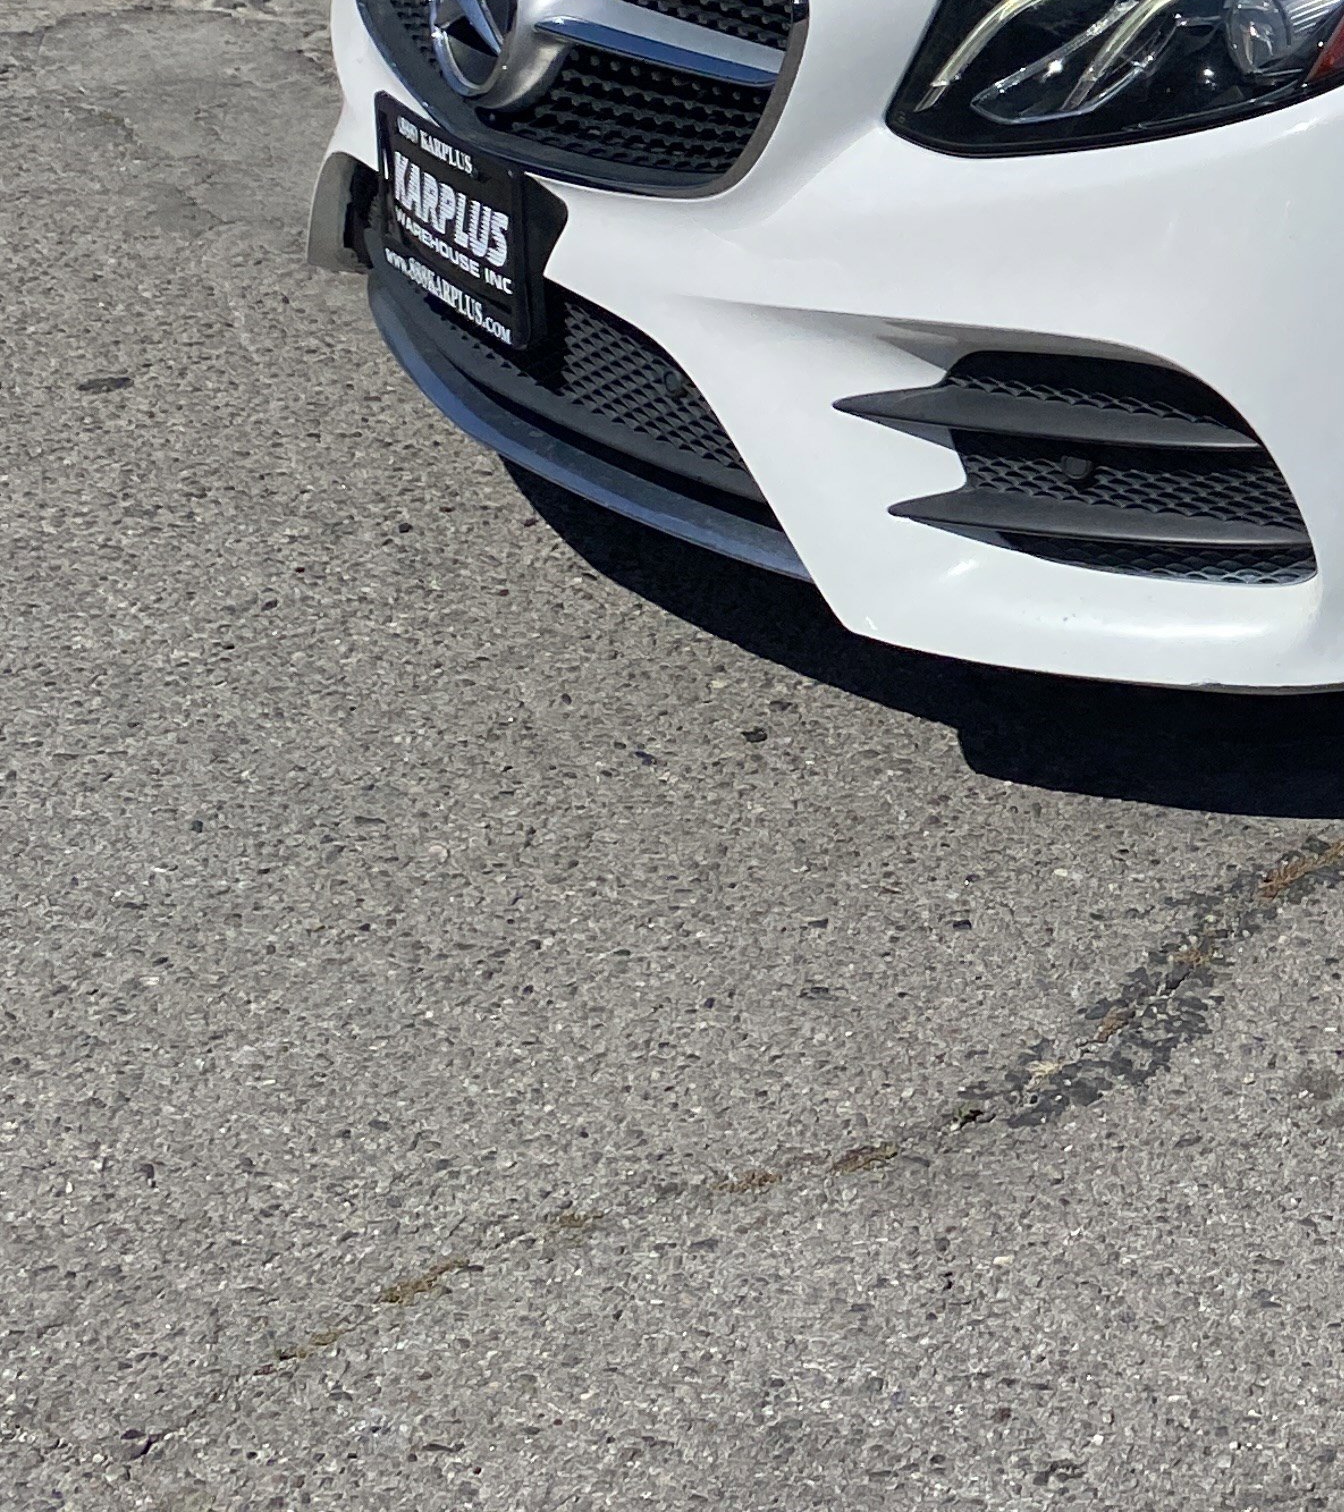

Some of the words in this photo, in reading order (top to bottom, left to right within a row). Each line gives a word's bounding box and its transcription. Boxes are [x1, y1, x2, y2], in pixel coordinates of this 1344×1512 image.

[419, 129, 473, 175] KARPLUS
[394, 151, 509, 268] KARPLUS
[394, 204, 481, 279] WAREHOUSE
[484, 267, 514, 295] INC
